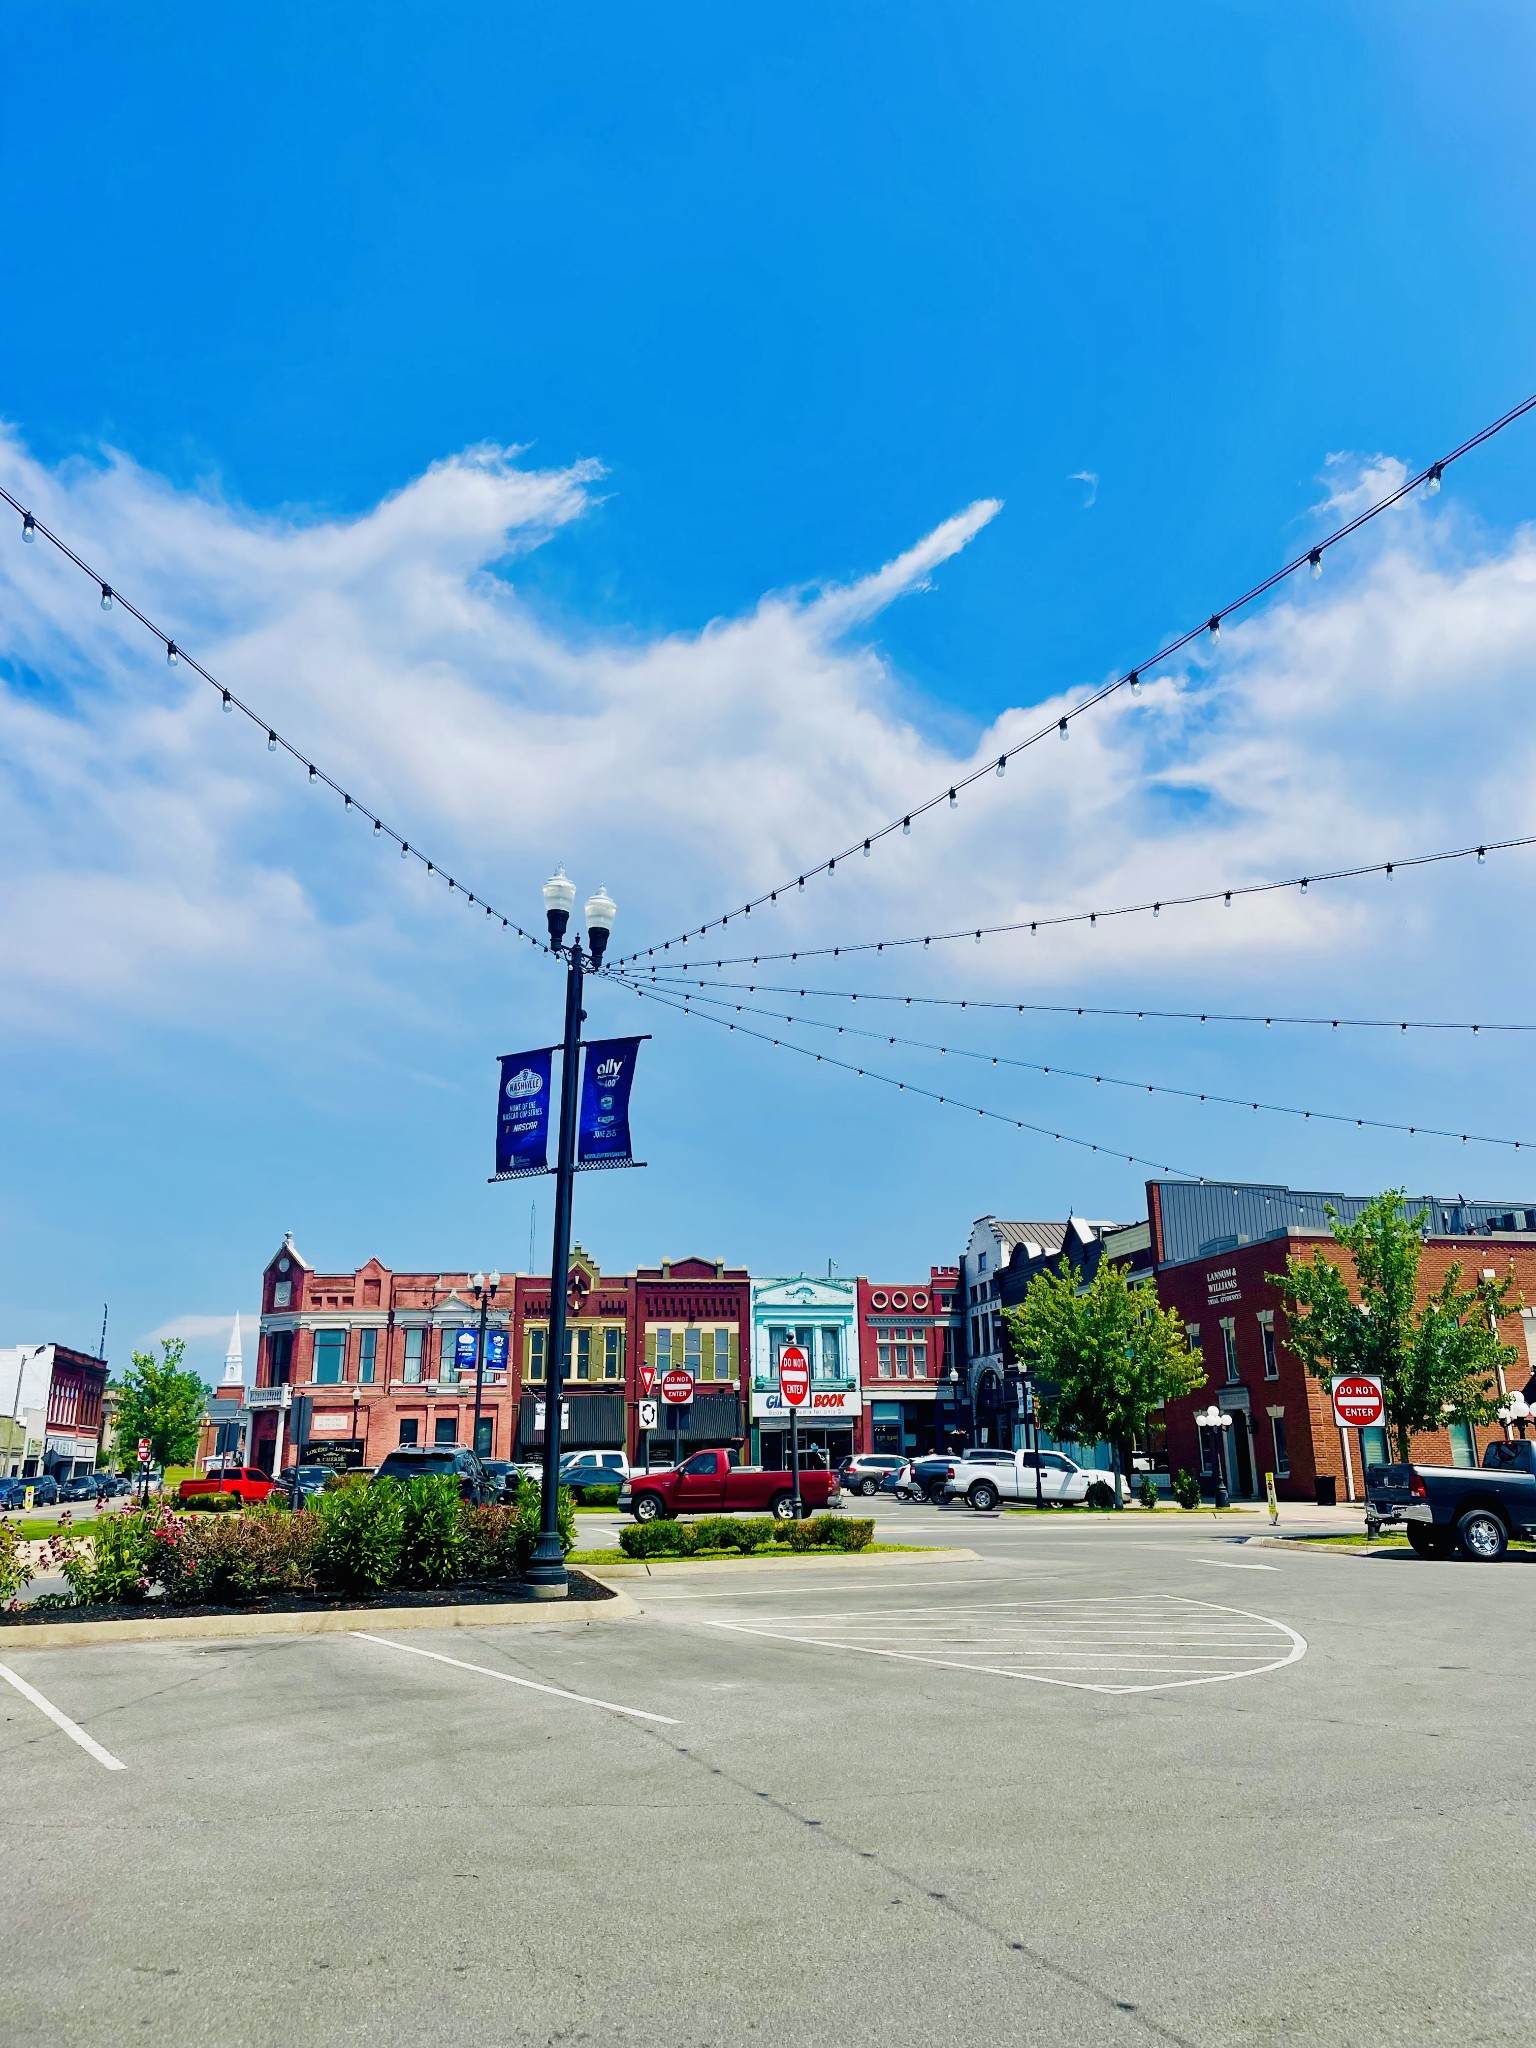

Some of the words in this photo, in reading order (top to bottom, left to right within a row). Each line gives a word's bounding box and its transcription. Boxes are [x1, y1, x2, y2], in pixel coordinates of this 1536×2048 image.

[597, 1059, 622, 1076] ally
[509, 1078, 540, 1093] NASHVILLE
[604, 1079, 616, 1088] 400
[513, 1121, 538, 1133] NASCAR
[1207, 1269, 1231, 1282] LANNOM
[1232, 1268, 1236, 1276] &
[1208, 1279, 1237, 1292] WILLIAMS
[783, 1357, 791, 1367] DO
[792, 1358, 804, 1368] NOT
[786, 1384, 803, 1394] ENTER
[1340, 1386, 1352, 1394] DO
[1356, 1386, 1374, 1394] NOT
[814, 1393, 846, 1408] BOOK
[1346, 1408, 1374, 1416] ENTER
